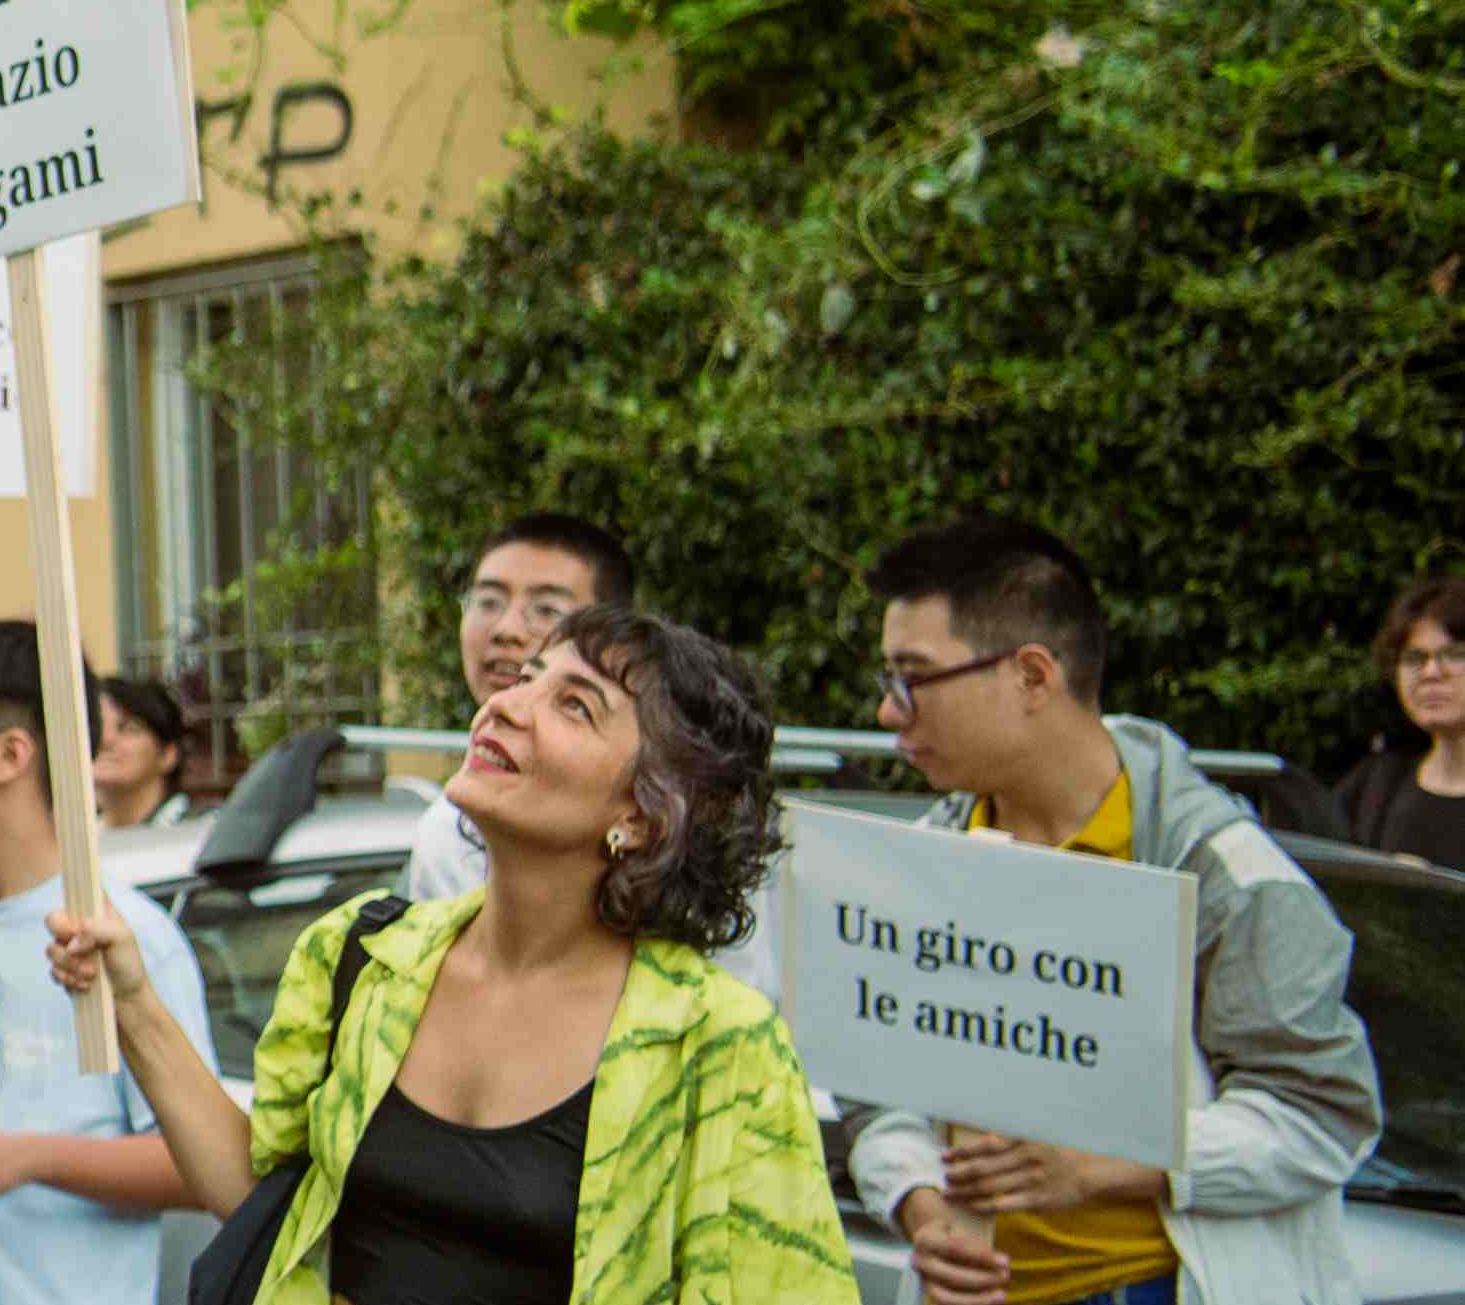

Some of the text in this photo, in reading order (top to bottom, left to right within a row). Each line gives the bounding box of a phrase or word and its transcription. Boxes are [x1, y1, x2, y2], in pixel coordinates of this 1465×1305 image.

[836, 903, 1123, 998] Un giro con
[857, 977, 1099, 1068] le amiche
